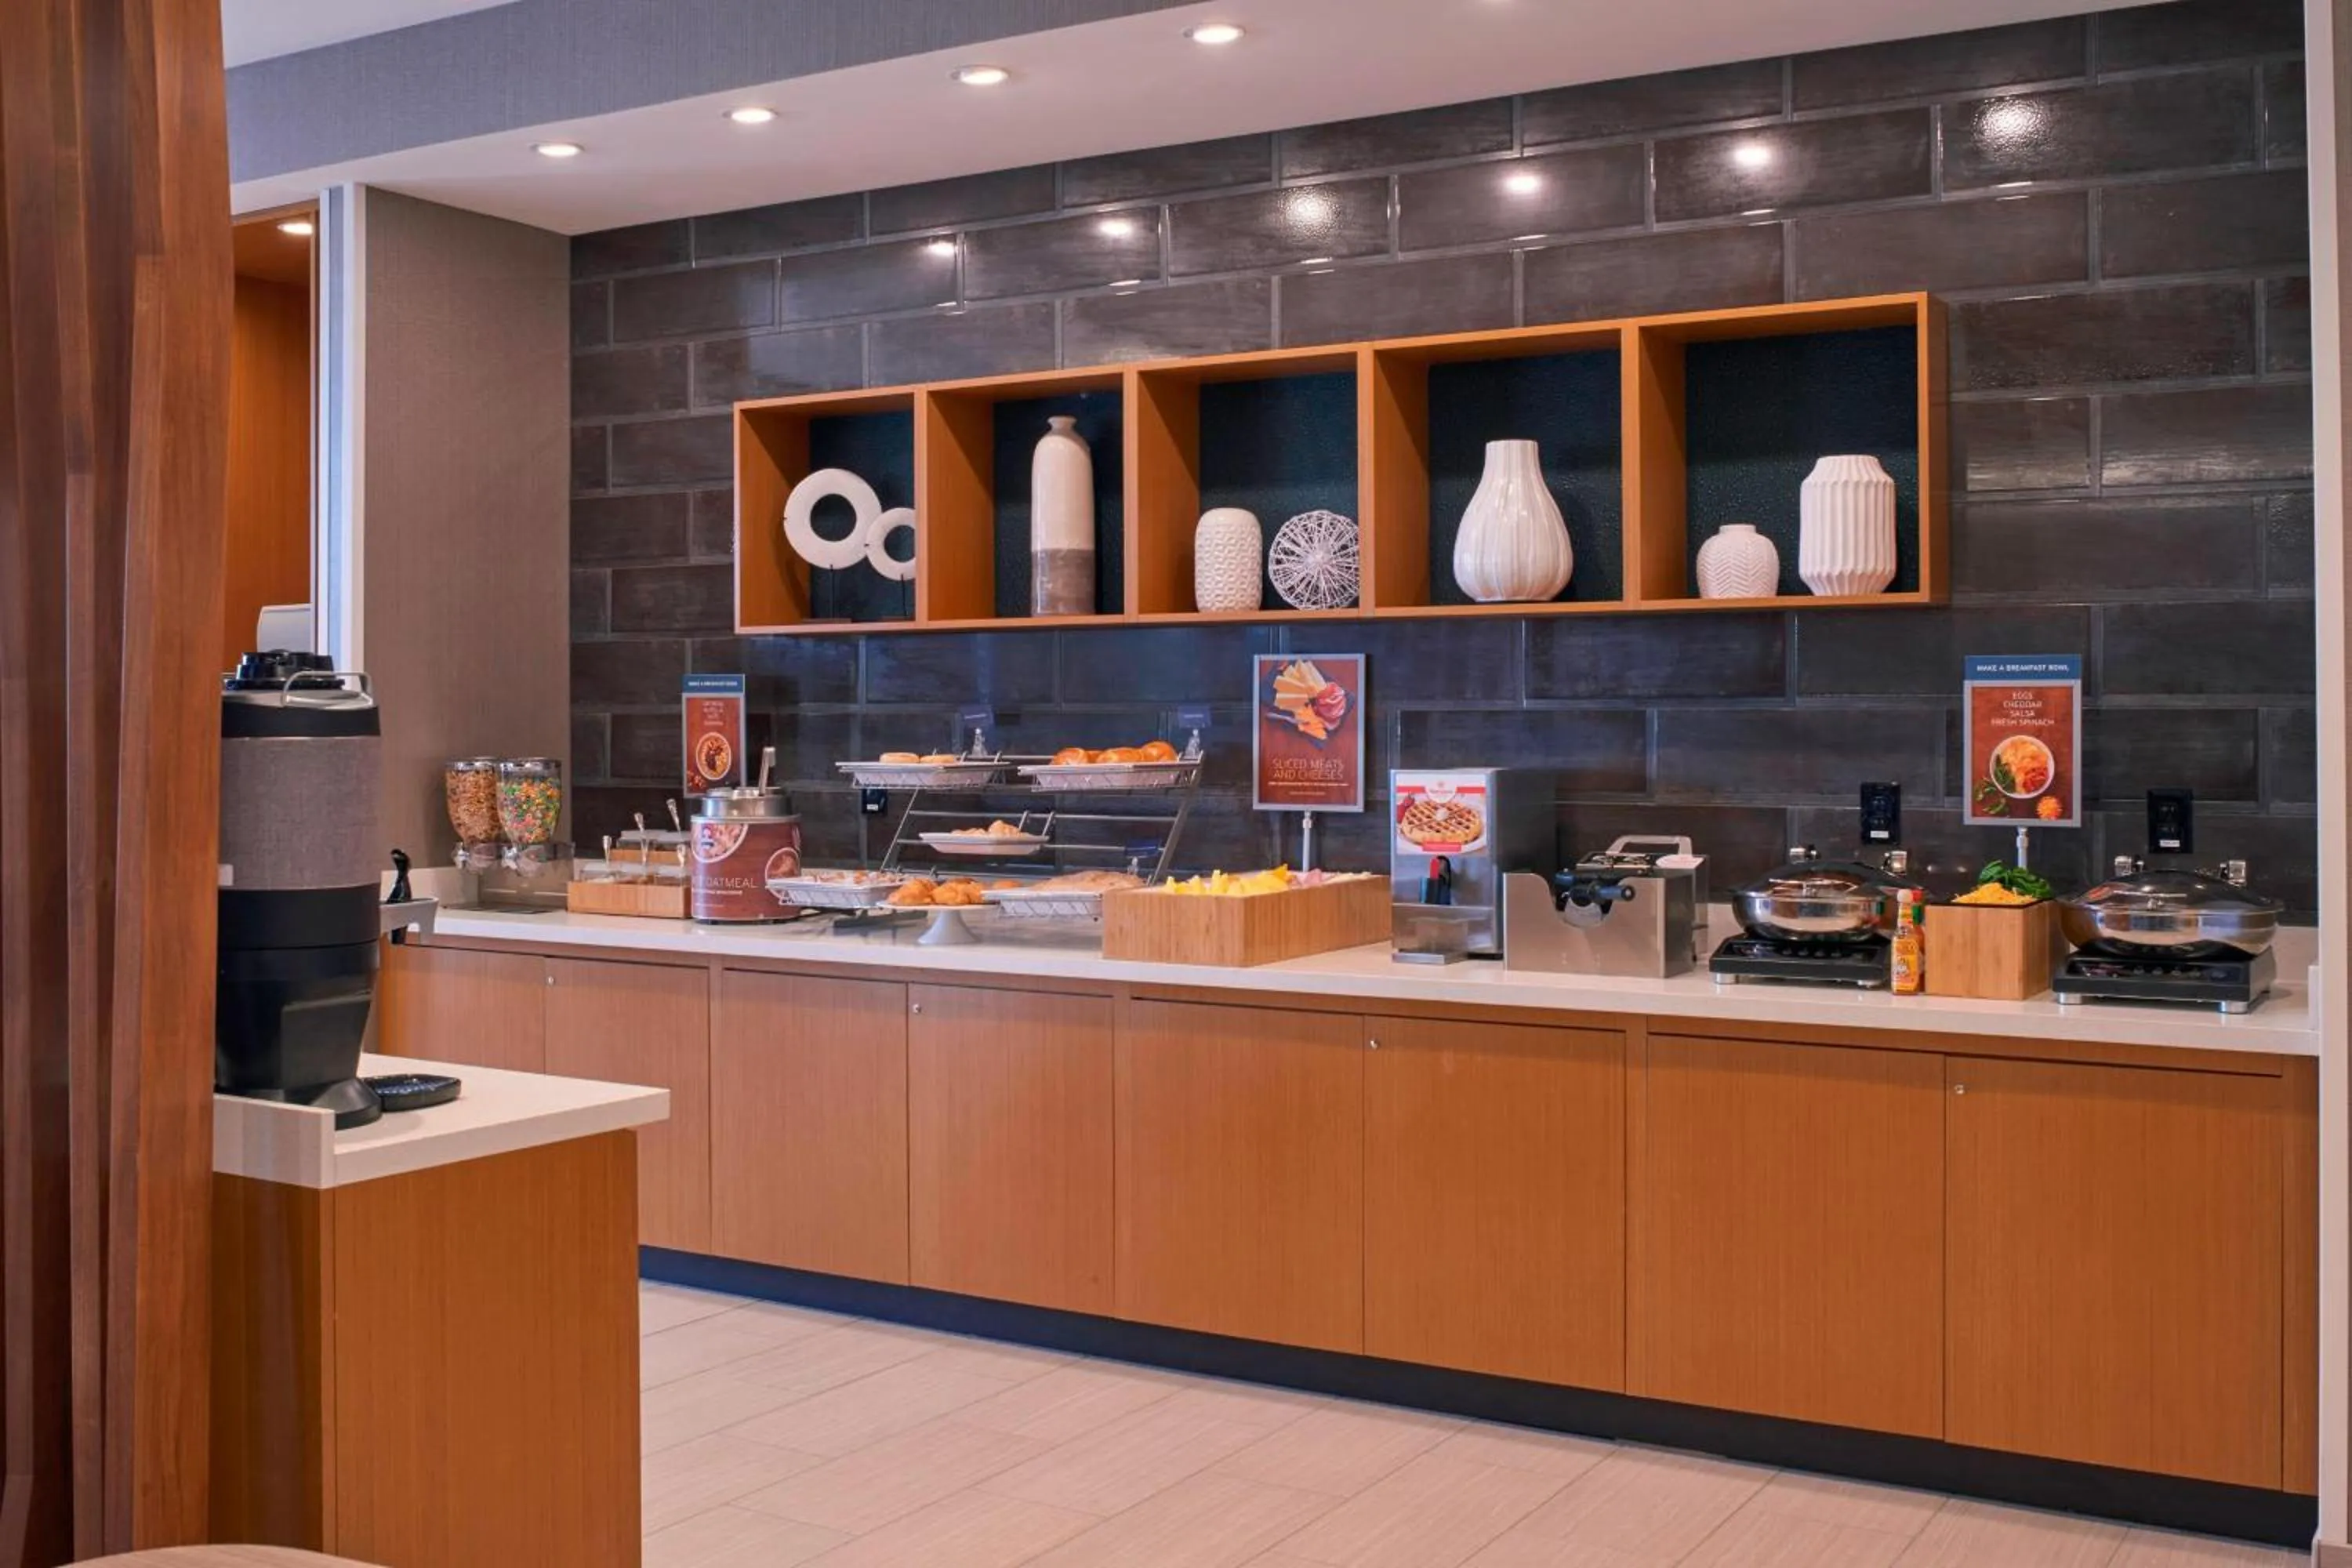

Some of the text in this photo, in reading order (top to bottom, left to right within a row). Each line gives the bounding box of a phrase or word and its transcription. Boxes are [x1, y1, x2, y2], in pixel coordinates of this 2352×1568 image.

[2048, 664, 2069, 673] BOWL
[2013, 691, 2033, 700] EGGS
[2019, 718, 2055, 727] SPINACH
[1272, 757, 1345, 769] SLICED MEATS
[1273, 769, 1344, 780] AND CHEESES
[706, 877, 759, 889] OATMEAL
